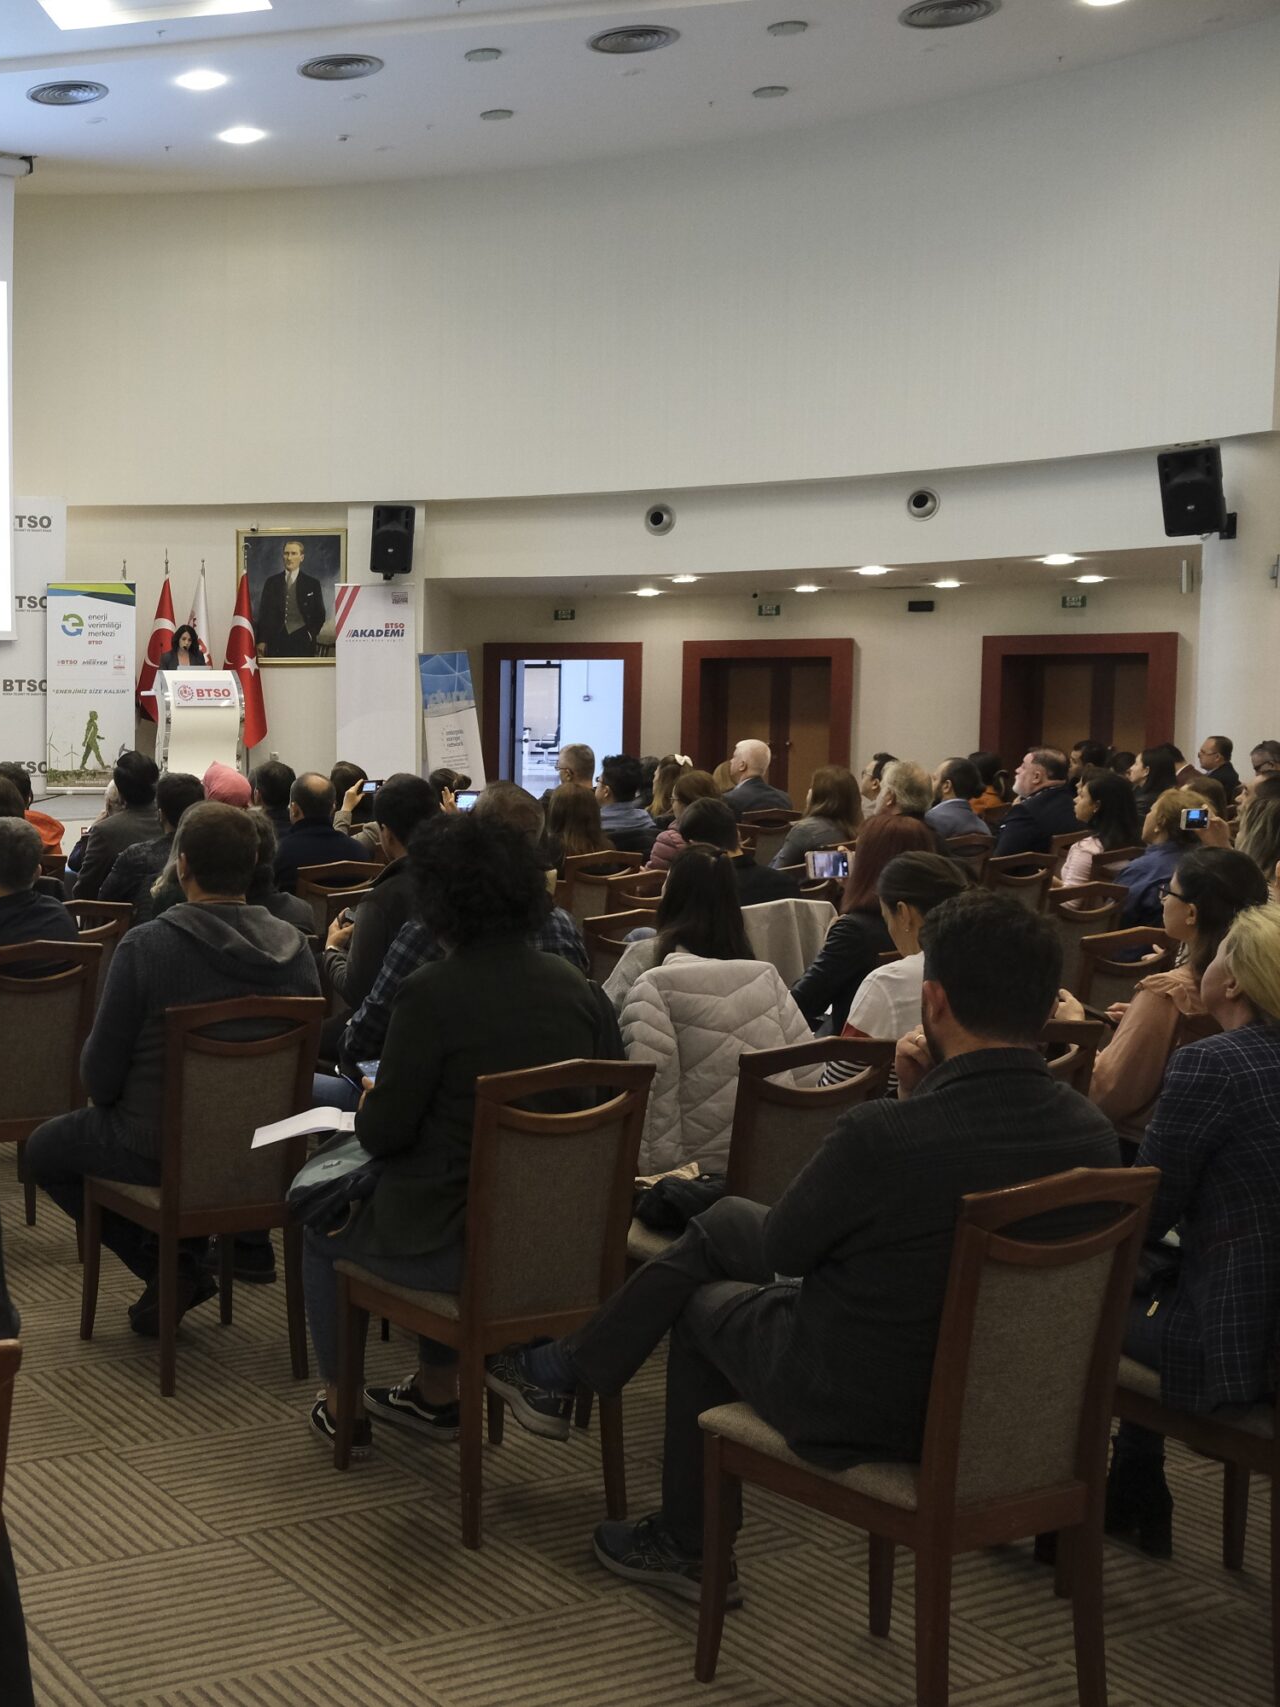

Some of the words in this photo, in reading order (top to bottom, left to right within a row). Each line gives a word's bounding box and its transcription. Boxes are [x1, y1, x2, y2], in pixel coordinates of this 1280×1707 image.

[14, 516, 52, 528] TSO
[14, 596, 47, 608] TSO
[88, 614, 108, 622] enerji
[88, 622, 122, 630] verimliliği
[196, 688, 231, 698] BTSO
